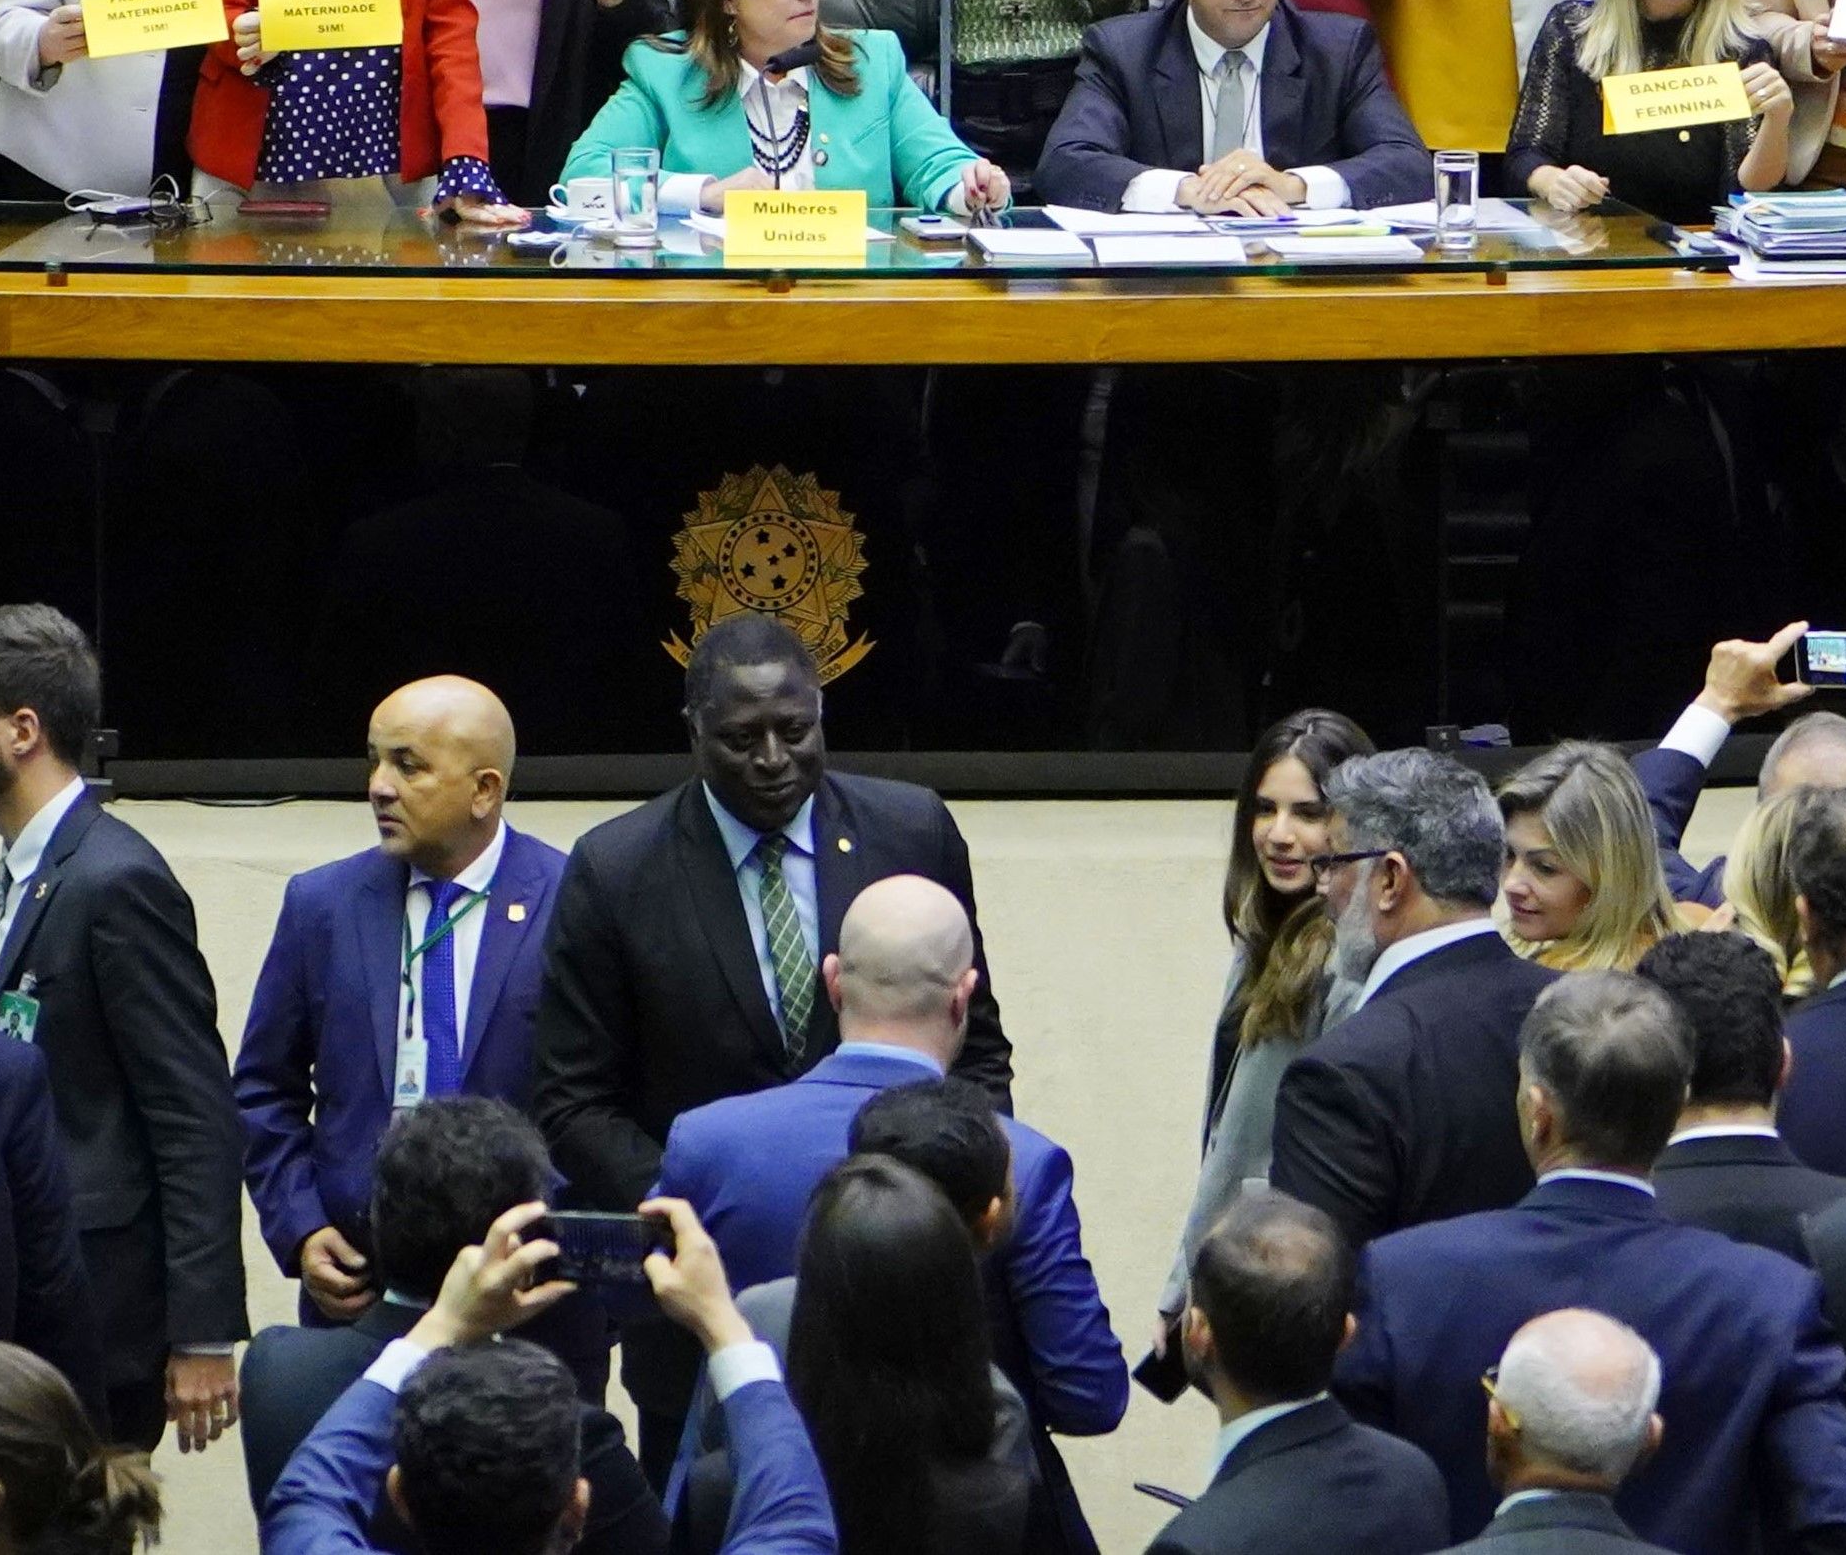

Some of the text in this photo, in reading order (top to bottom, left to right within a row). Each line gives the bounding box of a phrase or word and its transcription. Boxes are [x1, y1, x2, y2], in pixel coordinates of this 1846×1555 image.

[107, 1, 199, 20] MATERNIDADE
[284, 3, 376, 17] MATERNIDADE
[143, 23, 169, 33] SIM!
[317, 24, 344, 33] SIM!
[1629, 75, 1718, 95] BANCADA
[1635, 98, 1726, 119] FEMININA
[753, 202, 837, 215] Mulheres
[763, 230, 827, 242] Unidas
